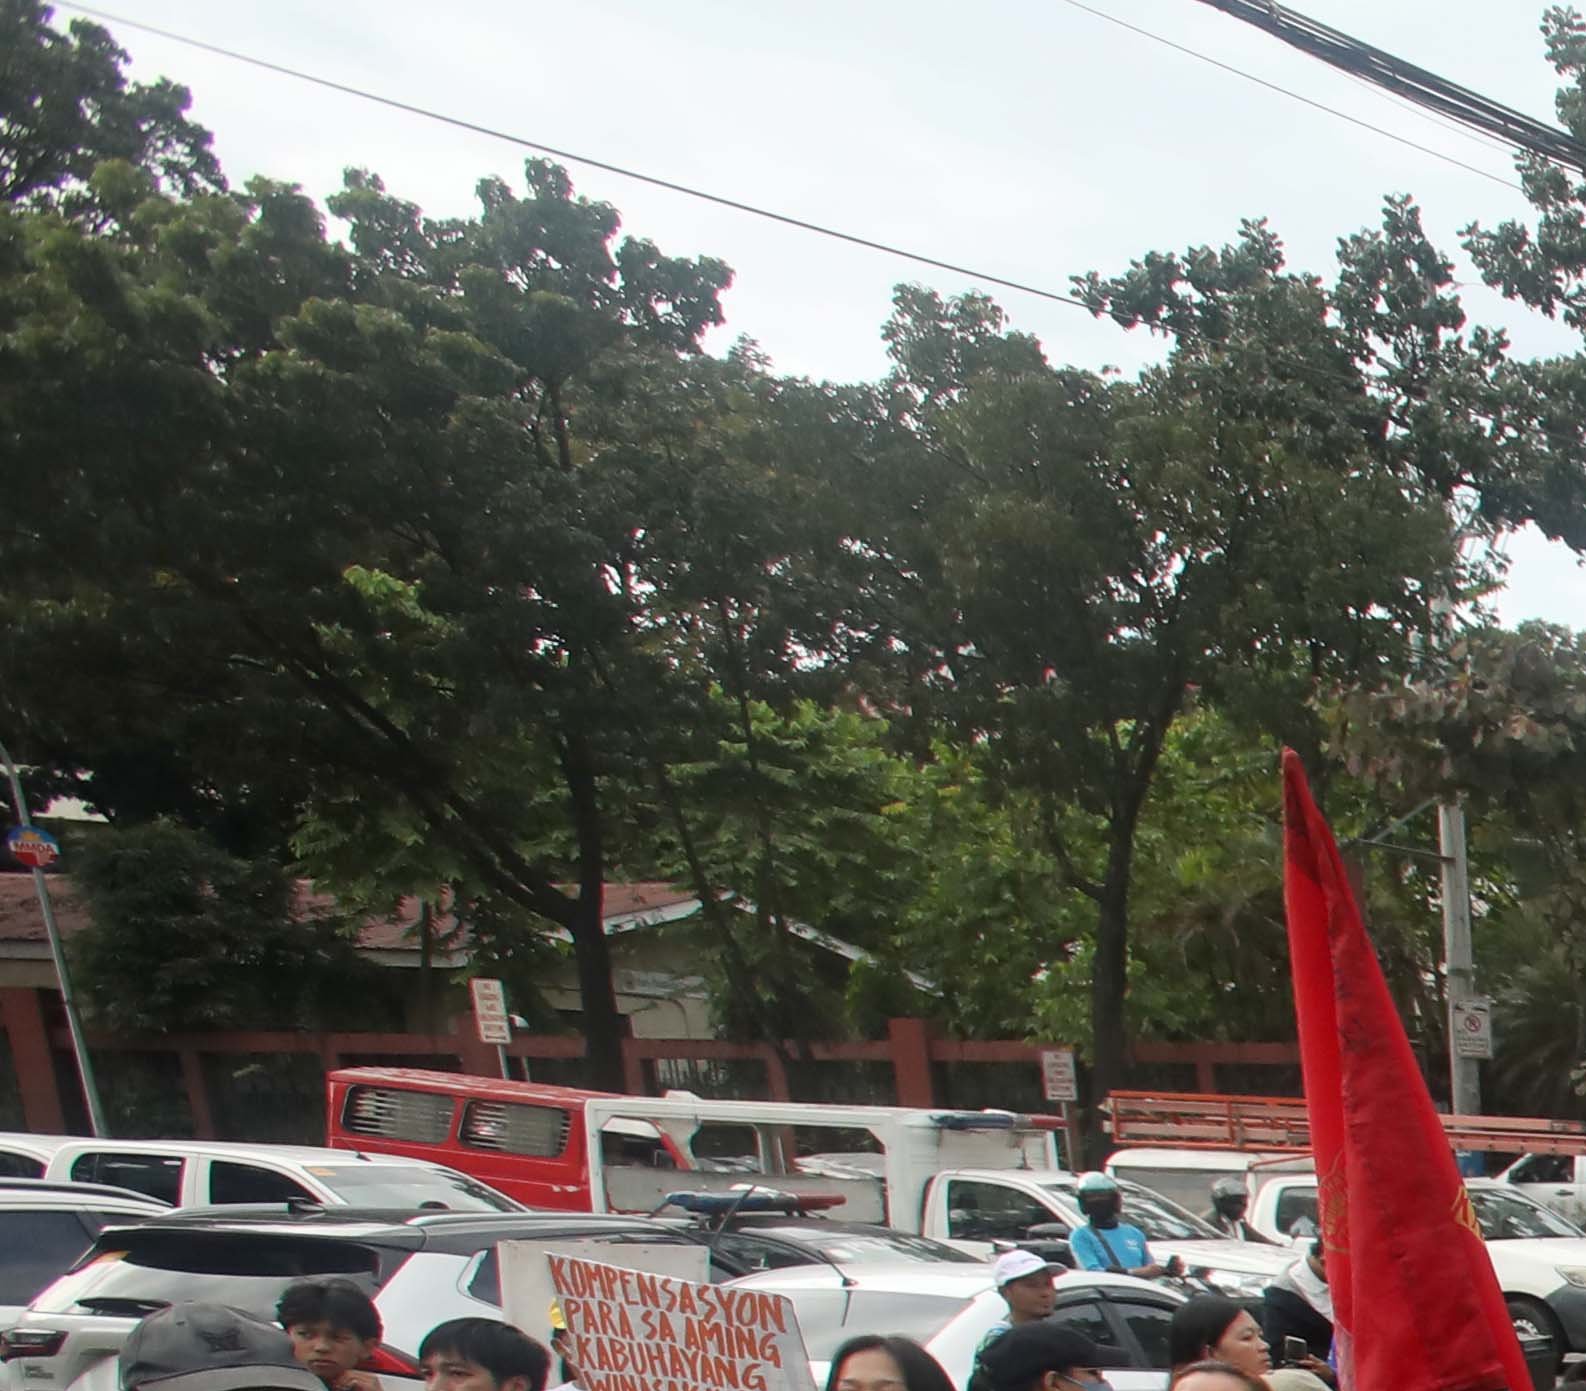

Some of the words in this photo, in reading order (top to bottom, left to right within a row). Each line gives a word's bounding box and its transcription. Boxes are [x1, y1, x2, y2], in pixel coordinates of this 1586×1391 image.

[550, 1255, 786, 1333] KOMPENSASYON
[564, 1298, 634, 1340] PARA
[644, 1310, 675, 1342] SA
[684, 1317, 782, 1367] AMING
